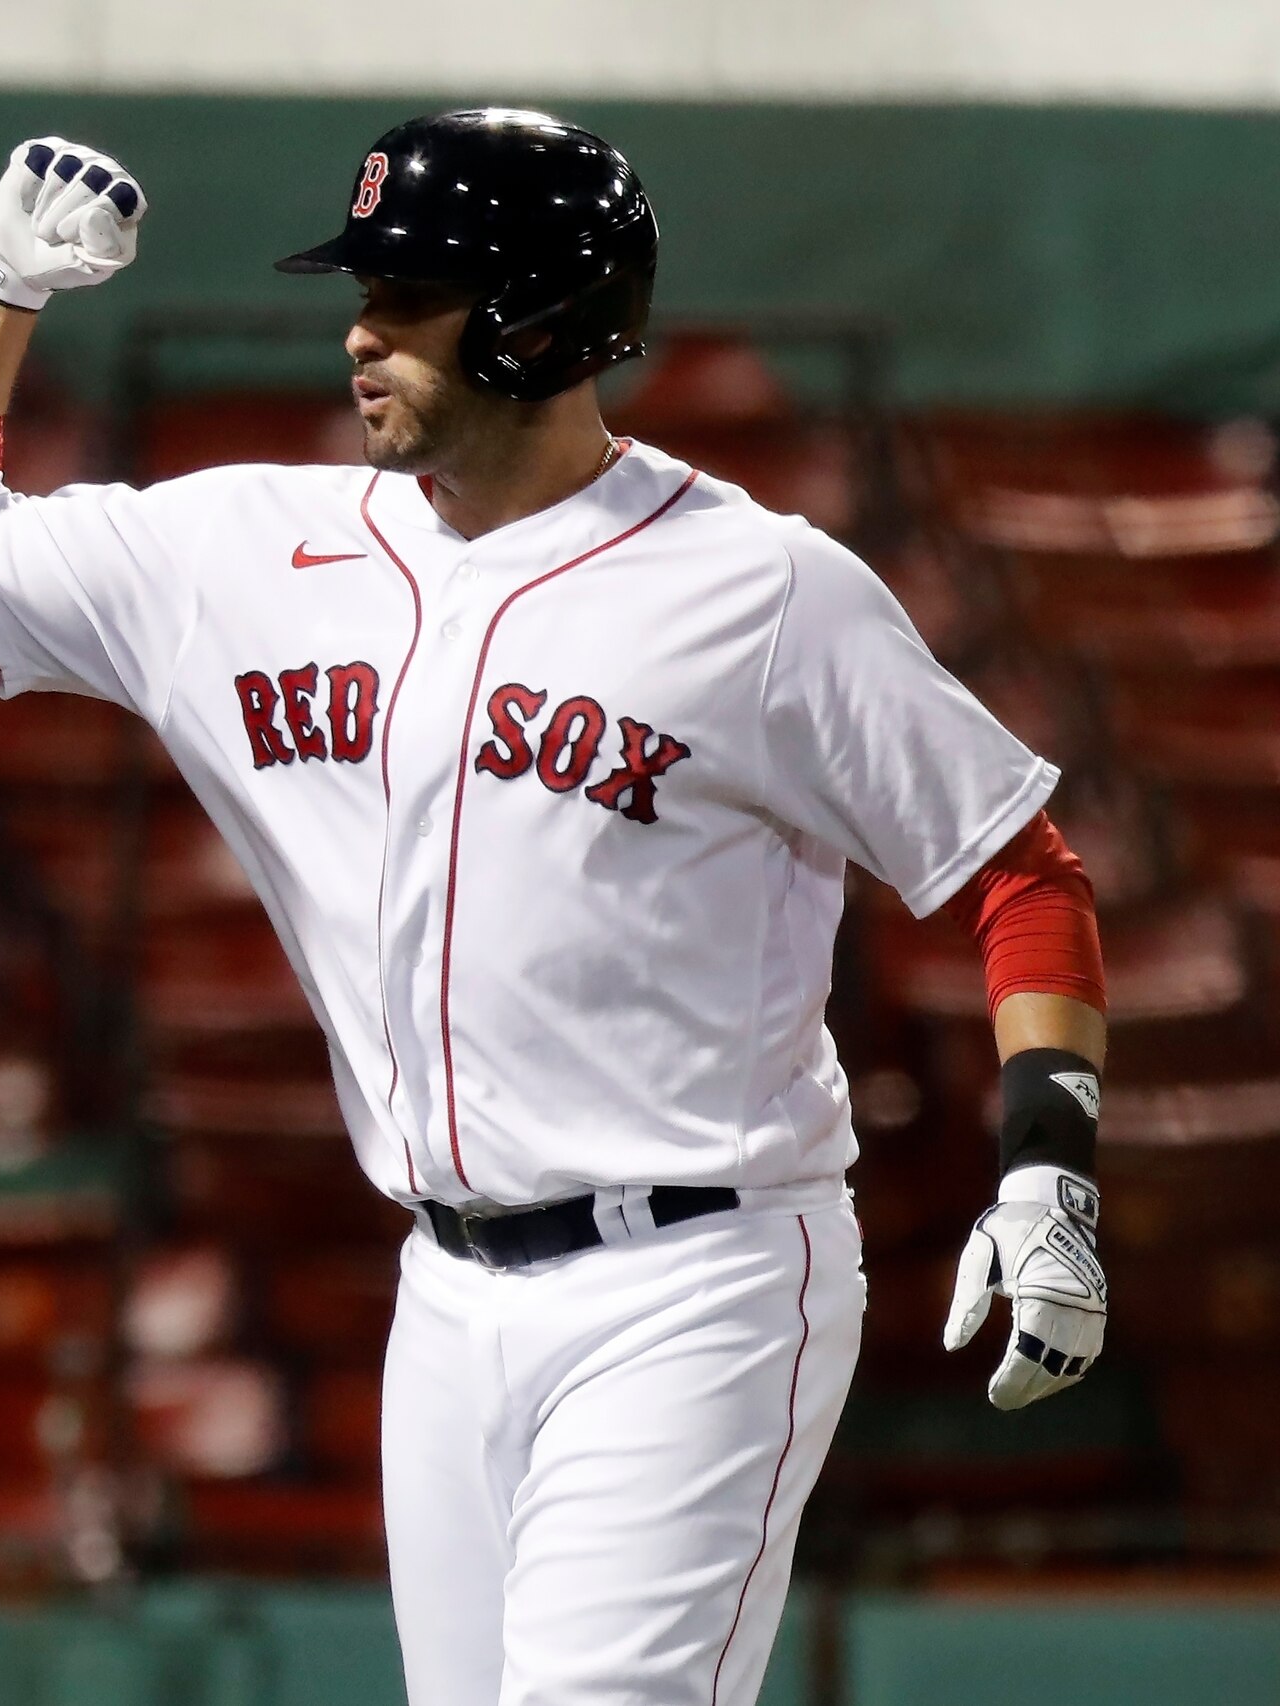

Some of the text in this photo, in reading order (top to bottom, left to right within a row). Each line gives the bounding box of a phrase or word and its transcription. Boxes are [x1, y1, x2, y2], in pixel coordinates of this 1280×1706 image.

[352, 152, 389, 218] B
[234, 661, 691, 825] RED SOX
